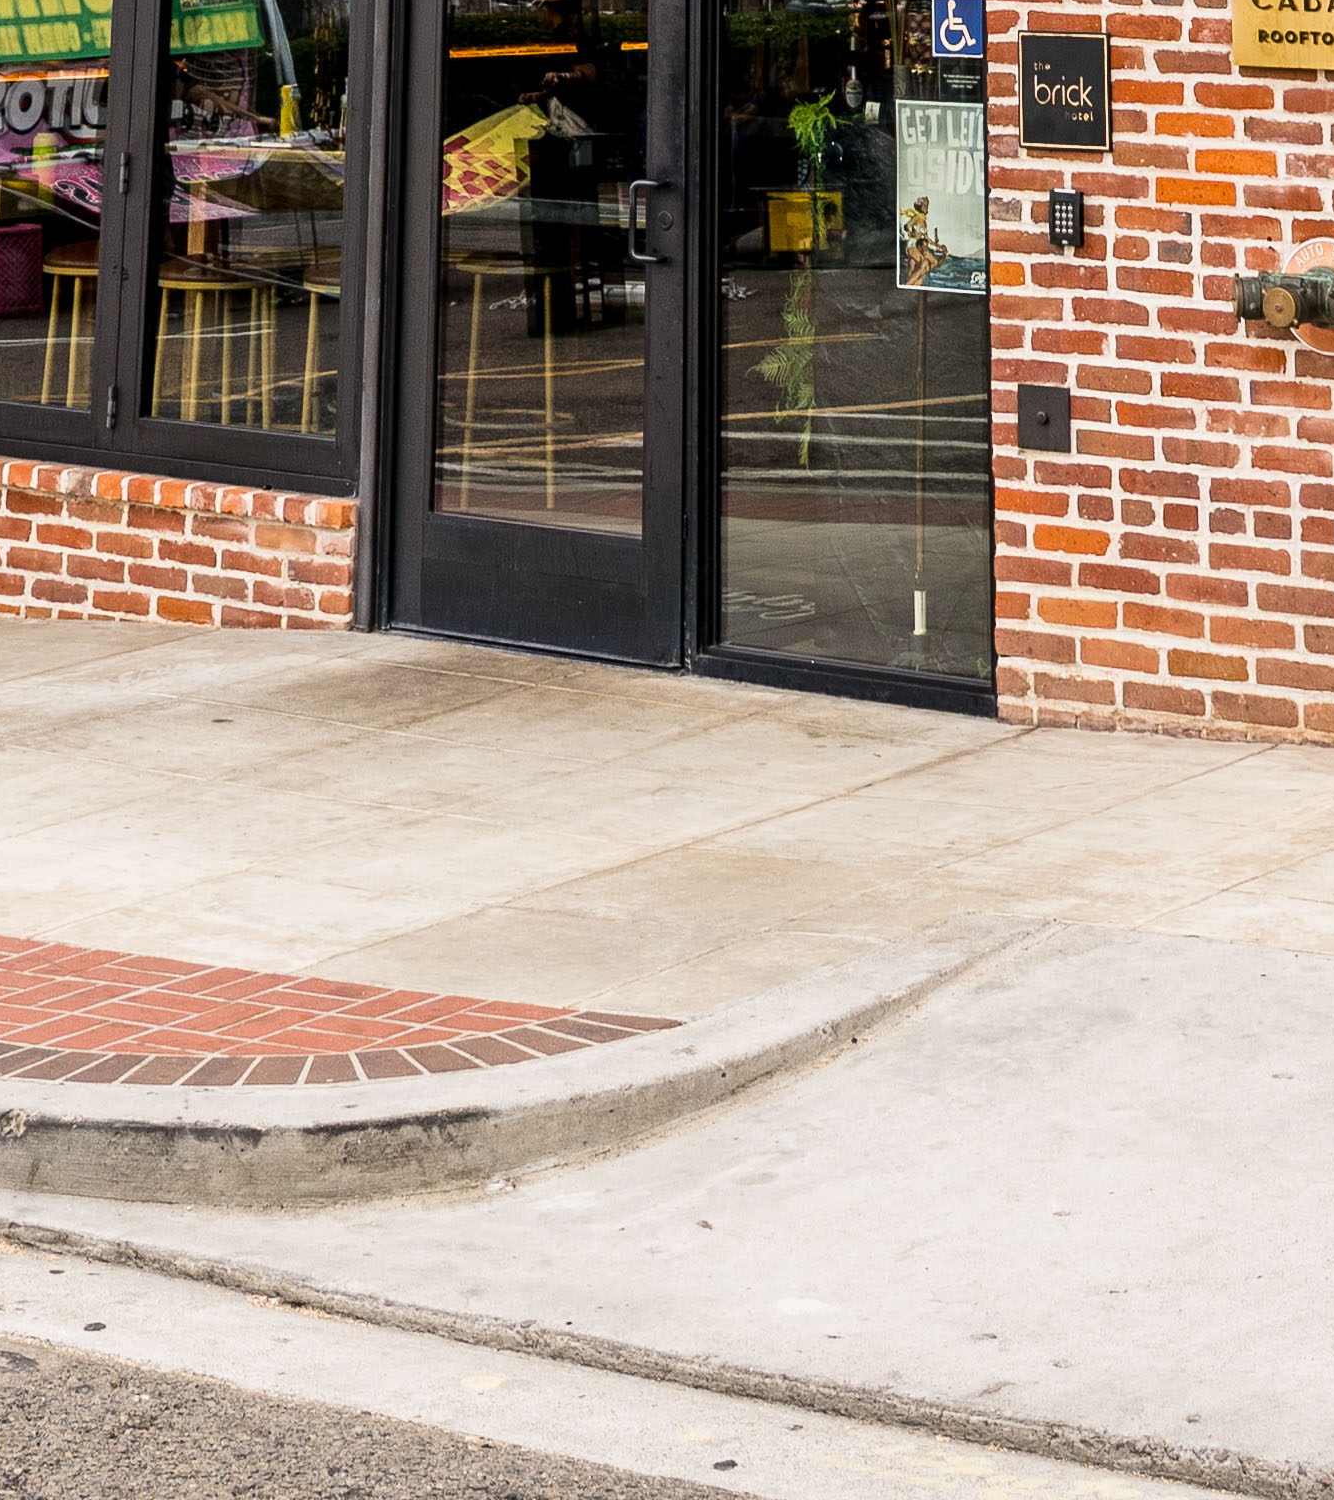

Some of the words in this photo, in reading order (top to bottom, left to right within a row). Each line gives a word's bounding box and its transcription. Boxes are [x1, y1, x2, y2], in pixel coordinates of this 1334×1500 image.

[1033, 60, 1051, 72] the
[1033, 73, 1093, 108] brick
[901, 106, 942, 146] GET
[1065, 109, 1094, 122] hotel
